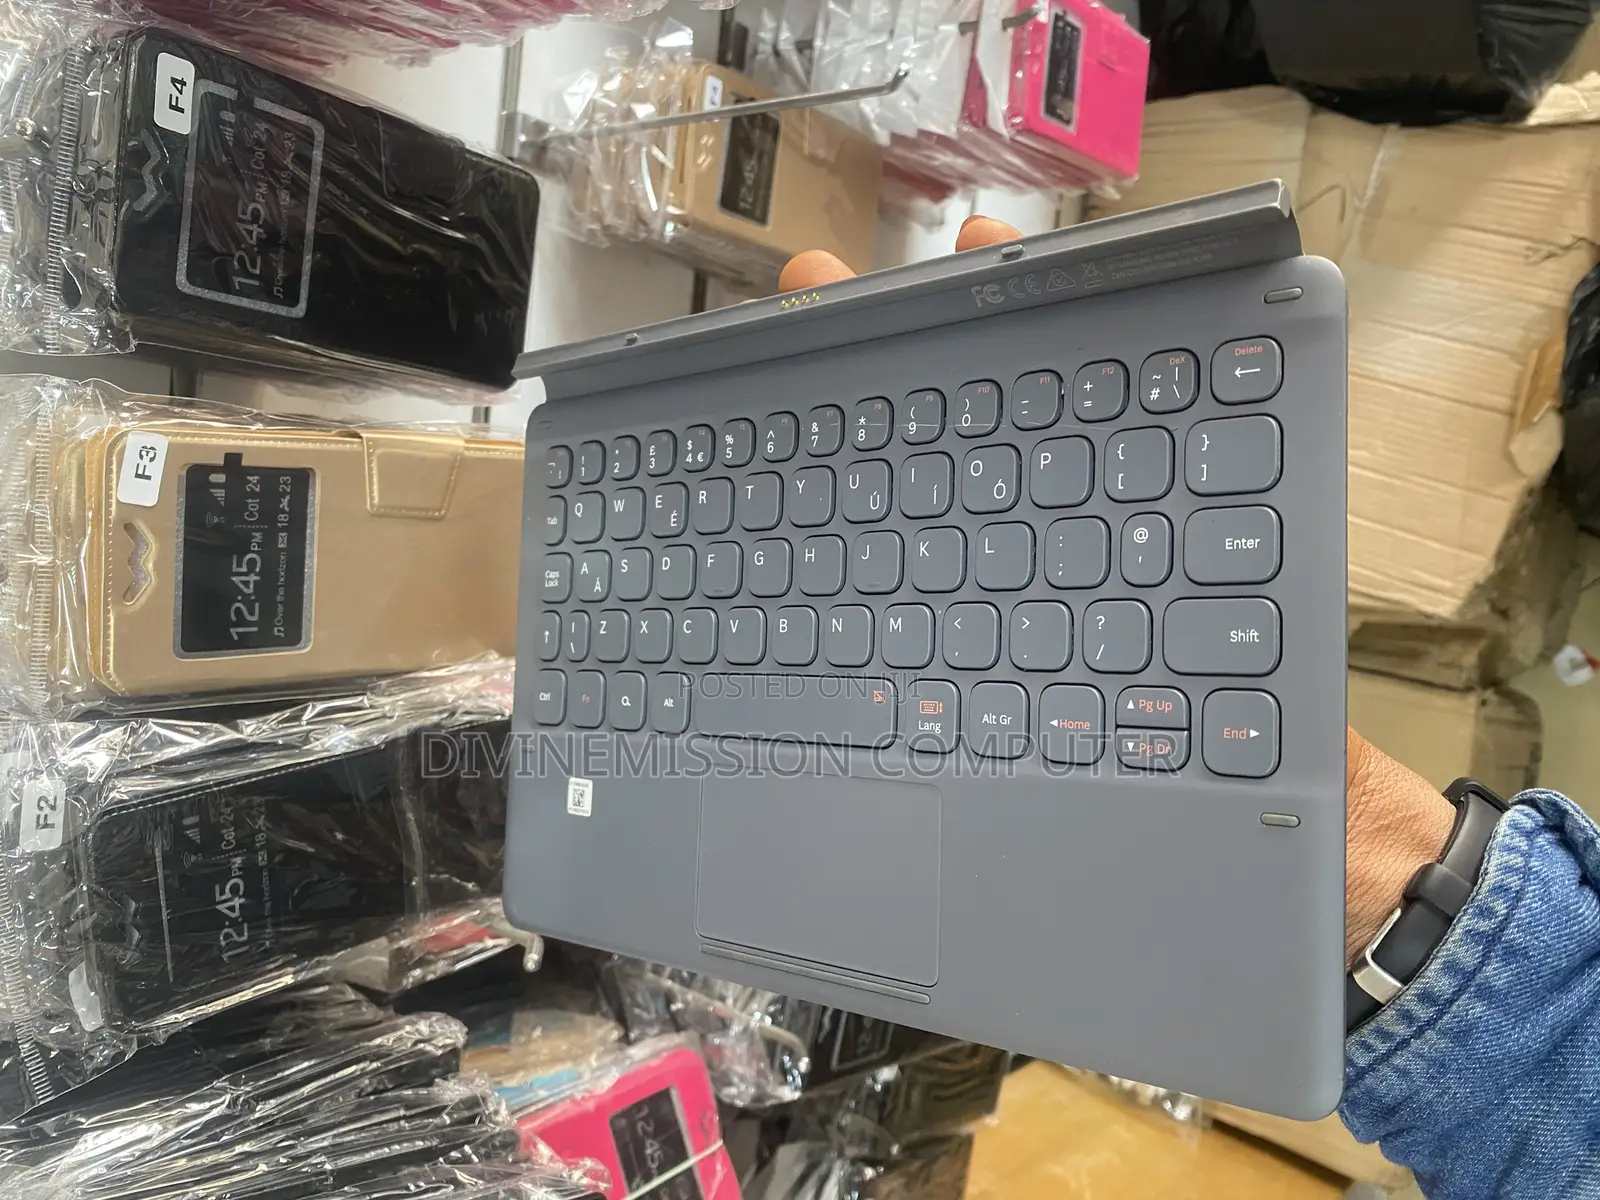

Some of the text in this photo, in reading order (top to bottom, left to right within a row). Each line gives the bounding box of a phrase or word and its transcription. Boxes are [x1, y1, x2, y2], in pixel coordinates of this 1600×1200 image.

[168, 76, 187, 114] F4
[232, 199, 266, 292] 12:45
[256, 182, 268, 203] PM
[1234, 345, 1263, 356] Delete
[1169, 356, 1186, 365] DeX
[1102, 366, 1115, 376] F12
[978, 386, 990, 394] F10
[1083, 380, 1093, 392] +
[1150, 387, 1160, 401] #
[811, 422, 819, 433] &
[961, 414, 971, 427] 0
[857, 429, 866, 441] 8
[908, 422, 917, 435] 9
[686, 440, 693, 451] $
[725, 434, 734, 445] %
[811, 435, 819, 448] 7
[1201, 433, 1210, 451] }
[649, 445, 656, 456] £
[725, 447, 733, 459] 5
[767, 442, 774, 454] 6
[1117, 443, 1125, 460] {
[134, 445, 157, 481] F3
[649, 458, 656, 469] 3
[685, 452, 704, 463] 4 €
[1040, 453, 1052, 469] P
[580, 467, 585, 476] 1
[613, 462, 620, 473] 2
[970, 460, 983, 477] O
[1201, 464, 1207, 481] ]
[247, 475, 260, 493] 24
[280, 476, 292, 493] 23
[796, 480, 806, 494] Y
[849, 474, 859, 489] U
[993, 478, 1006, 499] Ó
[1118, 473, 1124, 490] [
[699, 491, 707, 504] R
[745, 485, 754, 499] T
[932, 484, 938, 505] Í
[613, 500, 625, 512] W
[655, 495, 663, 508] E
[869, 491, 880, 510] Ú
[574, 502, 583, 518] Q
[278, 514, 289, 528] 18
[546, 516, 558, 525] Tab
[670, 511, 678, 527] É
[251, 532, 263, 551] PM
[1133, 527, 1149, 543] @
[919, 542, 930, 557] K
[984, 538, 995, 554] L
[1225, 537, 1261, 550] Enter
[754, 552, 764, 566] G
[805, 548, 815, 563] H
[861, 545, 870, 560] J
[580, 562, 589, 575] A
[621, 560, 628, 572] S
[662, 557, 671, 570] D
[707, 555, 715, 568] F
[545, 570, 560, 579] Caps
[545, 578, 559, 587] Lock
[593, 577, 602, 592] Á
[230, 554, 262, 641] 12:45
[600, 621, 607, 634] Z
[640, 621, 648, 634] X
[683, 620, 692, 634] C
[729, 619, 739, 633] V
[779, 619, 788, 633] B
[832, 618, 842, 633] N
[889, 618, 902, 632] M
[954, 617, 961, 630] <
[1021, 617, 1030, 630] >
[1096, 615, 1105, 630] ?
[1229, 629, 1260, 643] Shift
[1096, 644, 1104, 660] /
[539, 692, 551, 700] Ctrl
[664, 697, 673, 707] Alt
[1139, 700, 1173, 713] Pg Up
[982, 713, 1012, 725] Alt Gr
[1059, 719, 1091, 730] Home
[918, 720, 941, 734] Lang
[1223, 728, 1247, 740] End
[1139, 743, 1153, 757] Pg
[35, 795, 58, 831] F2
[220, 806, 235, 824] 24
[255, 833, 266, 848] 18
[231, 856, 243, 877] PM
[215, 878, 249, 964] 12:45
